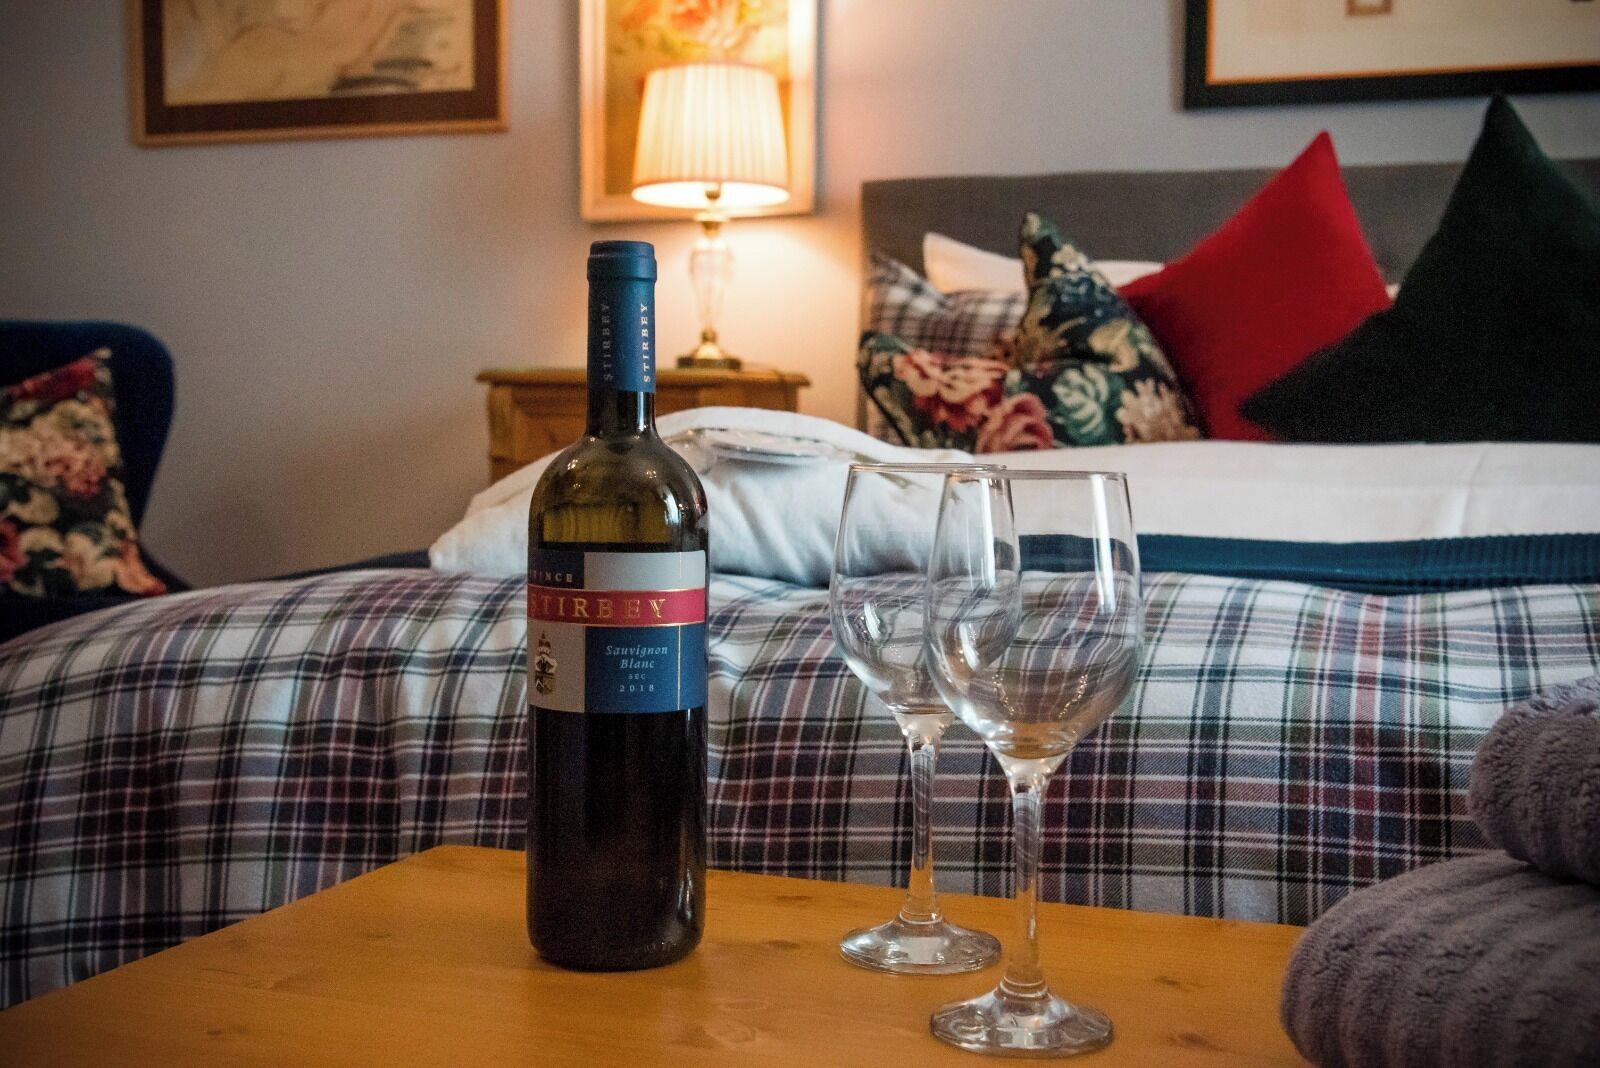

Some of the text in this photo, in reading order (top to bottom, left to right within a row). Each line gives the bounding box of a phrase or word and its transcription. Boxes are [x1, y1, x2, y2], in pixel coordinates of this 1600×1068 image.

[640, 302, 651, 383] STIRBEY
[605, 644, 668, 658] Sauvignon
[620, 658, 655, 669] Blanc
[619, 684, 655, 693] 2018
